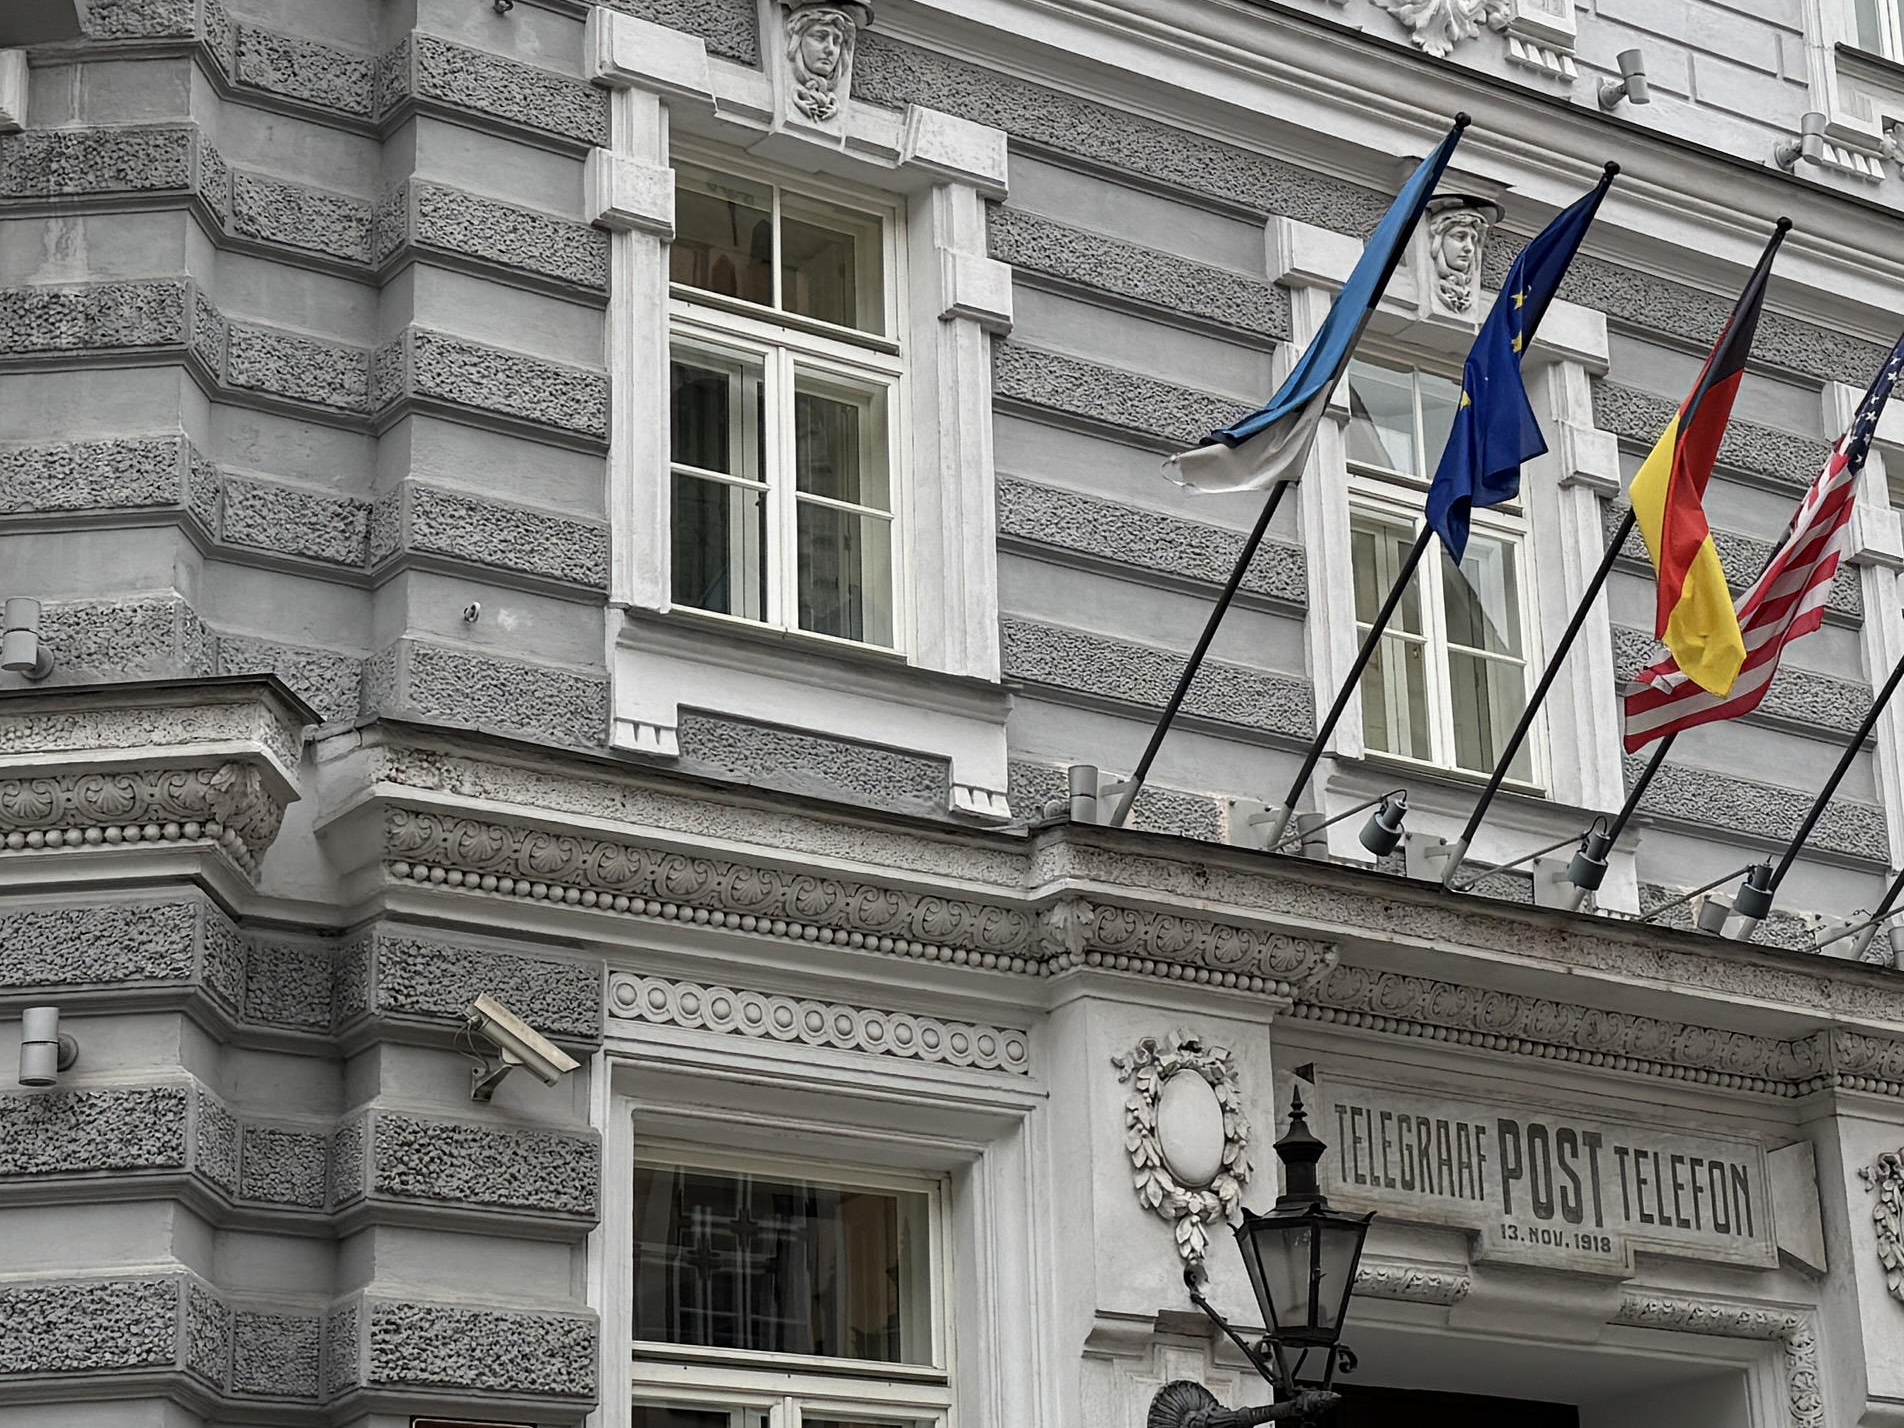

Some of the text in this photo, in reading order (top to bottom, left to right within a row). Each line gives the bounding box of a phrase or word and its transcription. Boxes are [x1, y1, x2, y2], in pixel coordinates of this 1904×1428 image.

[1335, 1104, 1754, 1237] TELEGRAAF POST TELEFON
[1501, 1223, 1612, 1253] 13. NOV. 1918
